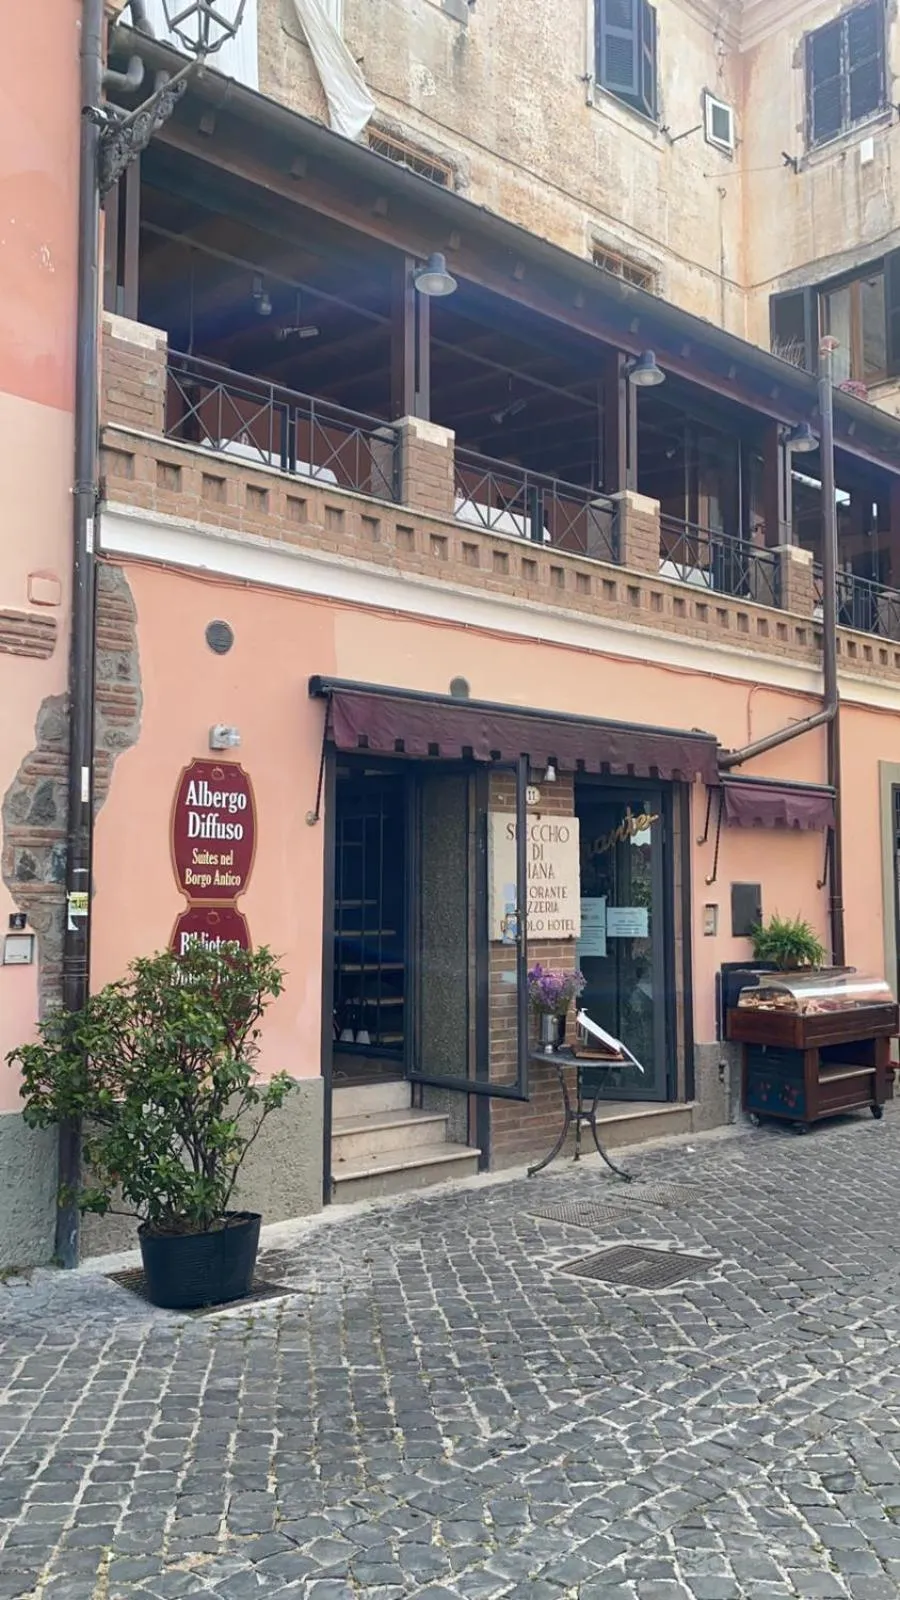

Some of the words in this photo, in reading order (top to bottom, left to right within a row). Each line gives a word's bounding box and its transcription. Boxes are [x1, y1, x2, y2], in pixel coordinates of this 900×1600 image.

[185, 780, 247, 813] Albergo
[528, 790, 536, 801] 11
[187, 811, 244, 840] Diffuso
[506, 823, 570, 843] SCCHIO
[192, 847, 219, 865] Suites
[220, 850, 234, 866] nel
[532, 842, 544, 861] DI
[185, 868, 212, 888] Borgo
[213, 869, 241, 886] Antico
[527, 861, 556, 880] IANA
[529, 885, 568, 899] ORANTE
[527, 900, 560, 914] ZZERIA
[547, 920, 576, 931] HOTEL
